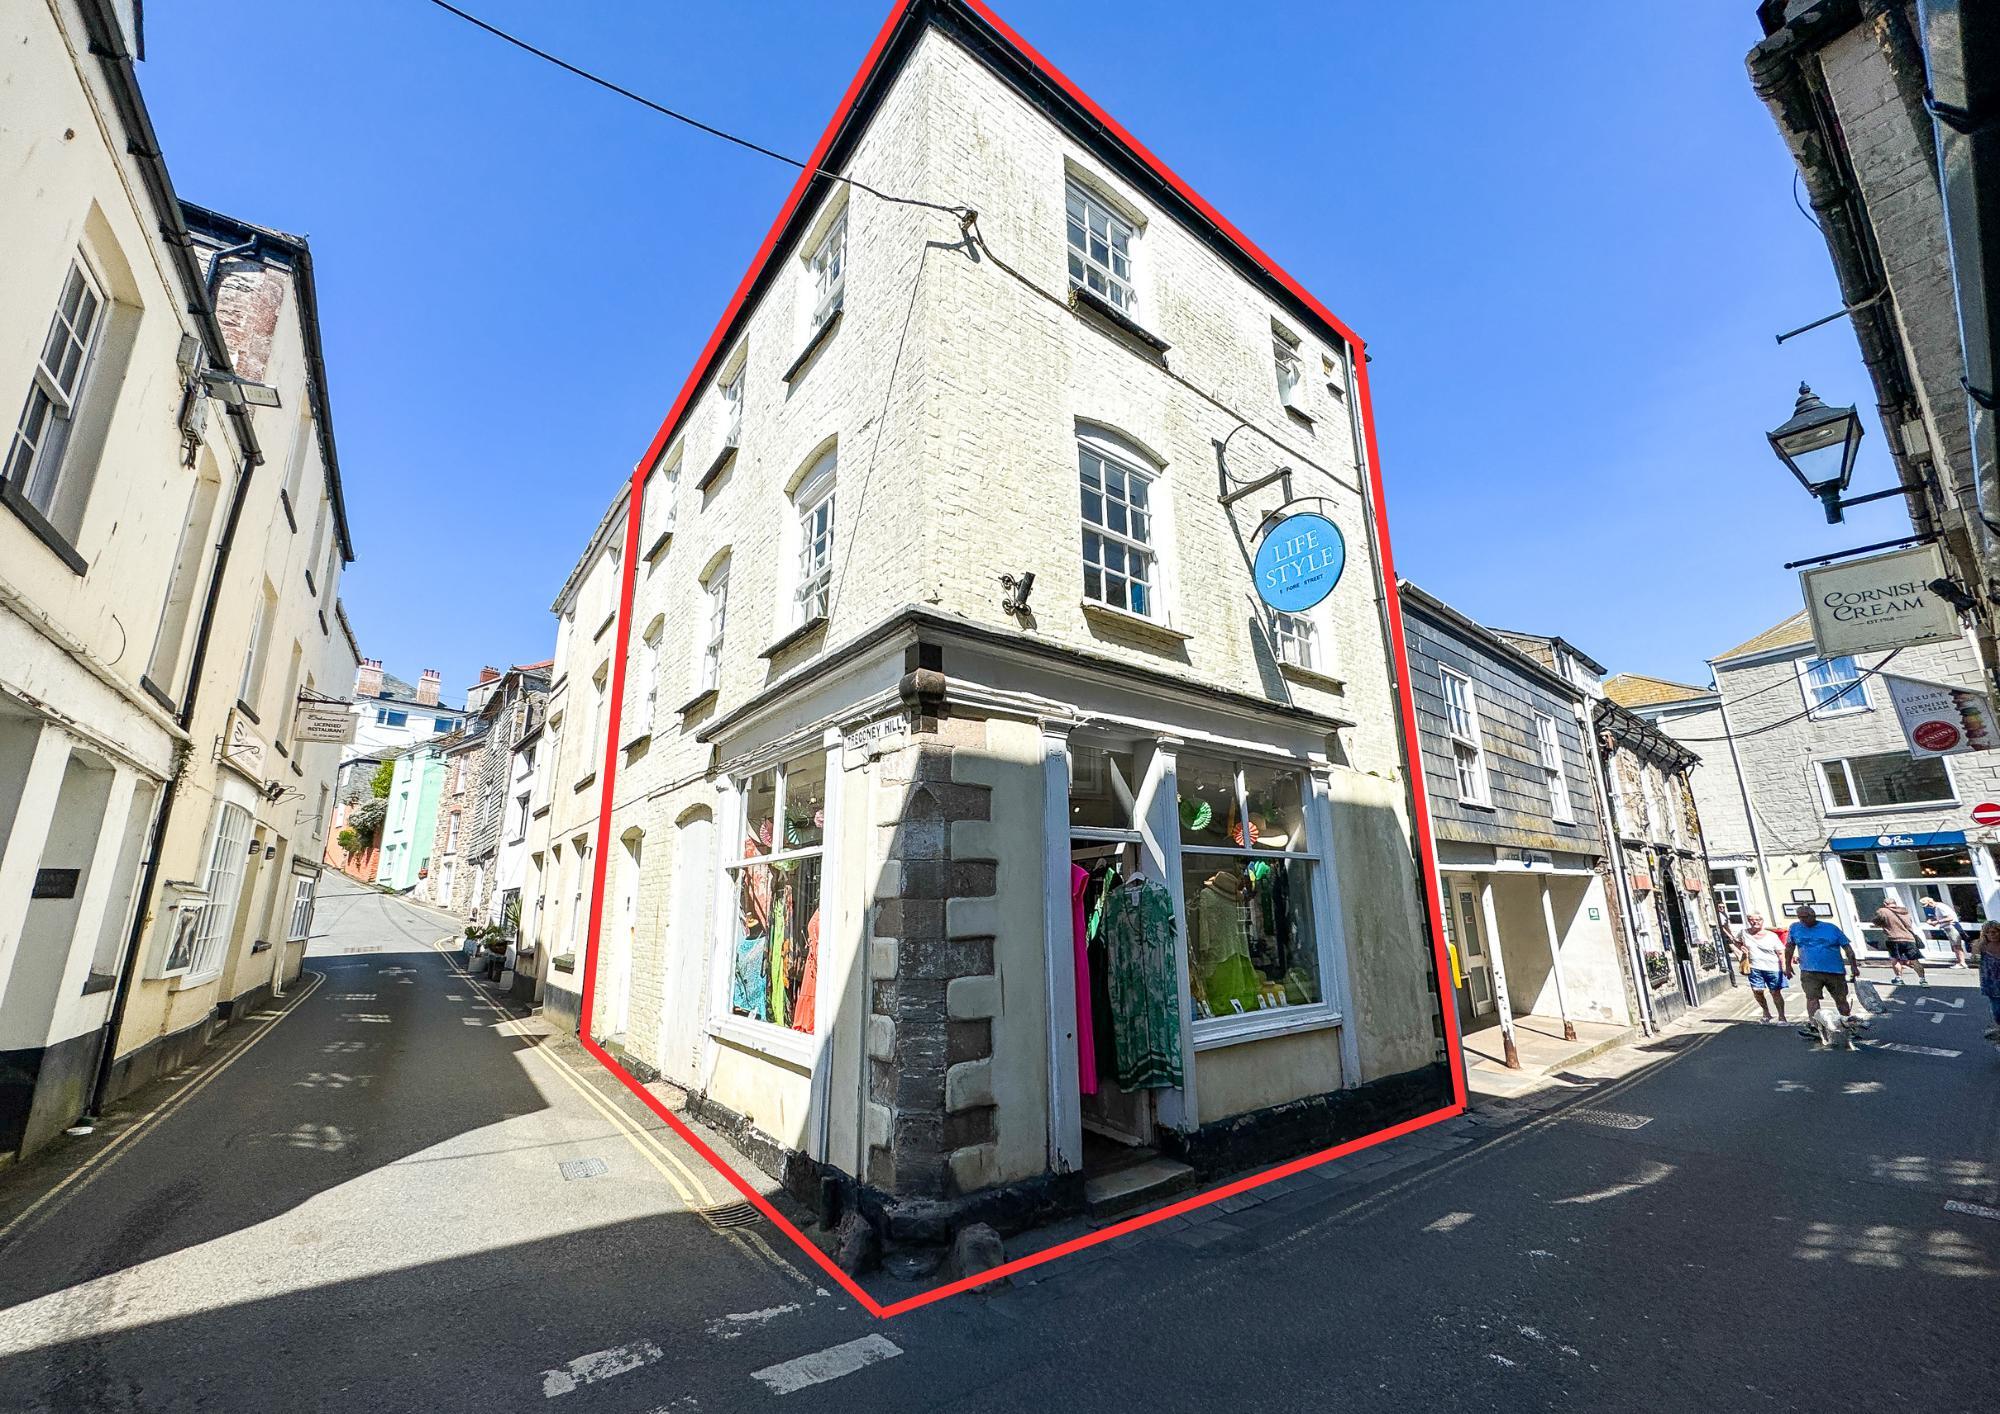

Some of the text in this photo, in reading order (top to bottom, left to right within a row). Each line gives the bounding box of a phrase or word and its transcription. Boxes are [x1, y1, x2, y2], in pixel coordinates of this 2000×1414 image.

[1273, 529, 1319, 563] LIFE
[1266, 546, 1334, 588] STYLE
[1286, 583, 1300, 592] FORE
[1303, 573, 1324, 585] STREET
[1824, 580, 1927, 608] CORNISH
[1833, 596, 1924, 622] CREAM
[1901, 692, 1943, 704] LUXURY
[1904, 700, 1948, 712] CORNISH
[1922, 705, 1950, 714] CREAM
[884, 718, 902, 735] HILL
